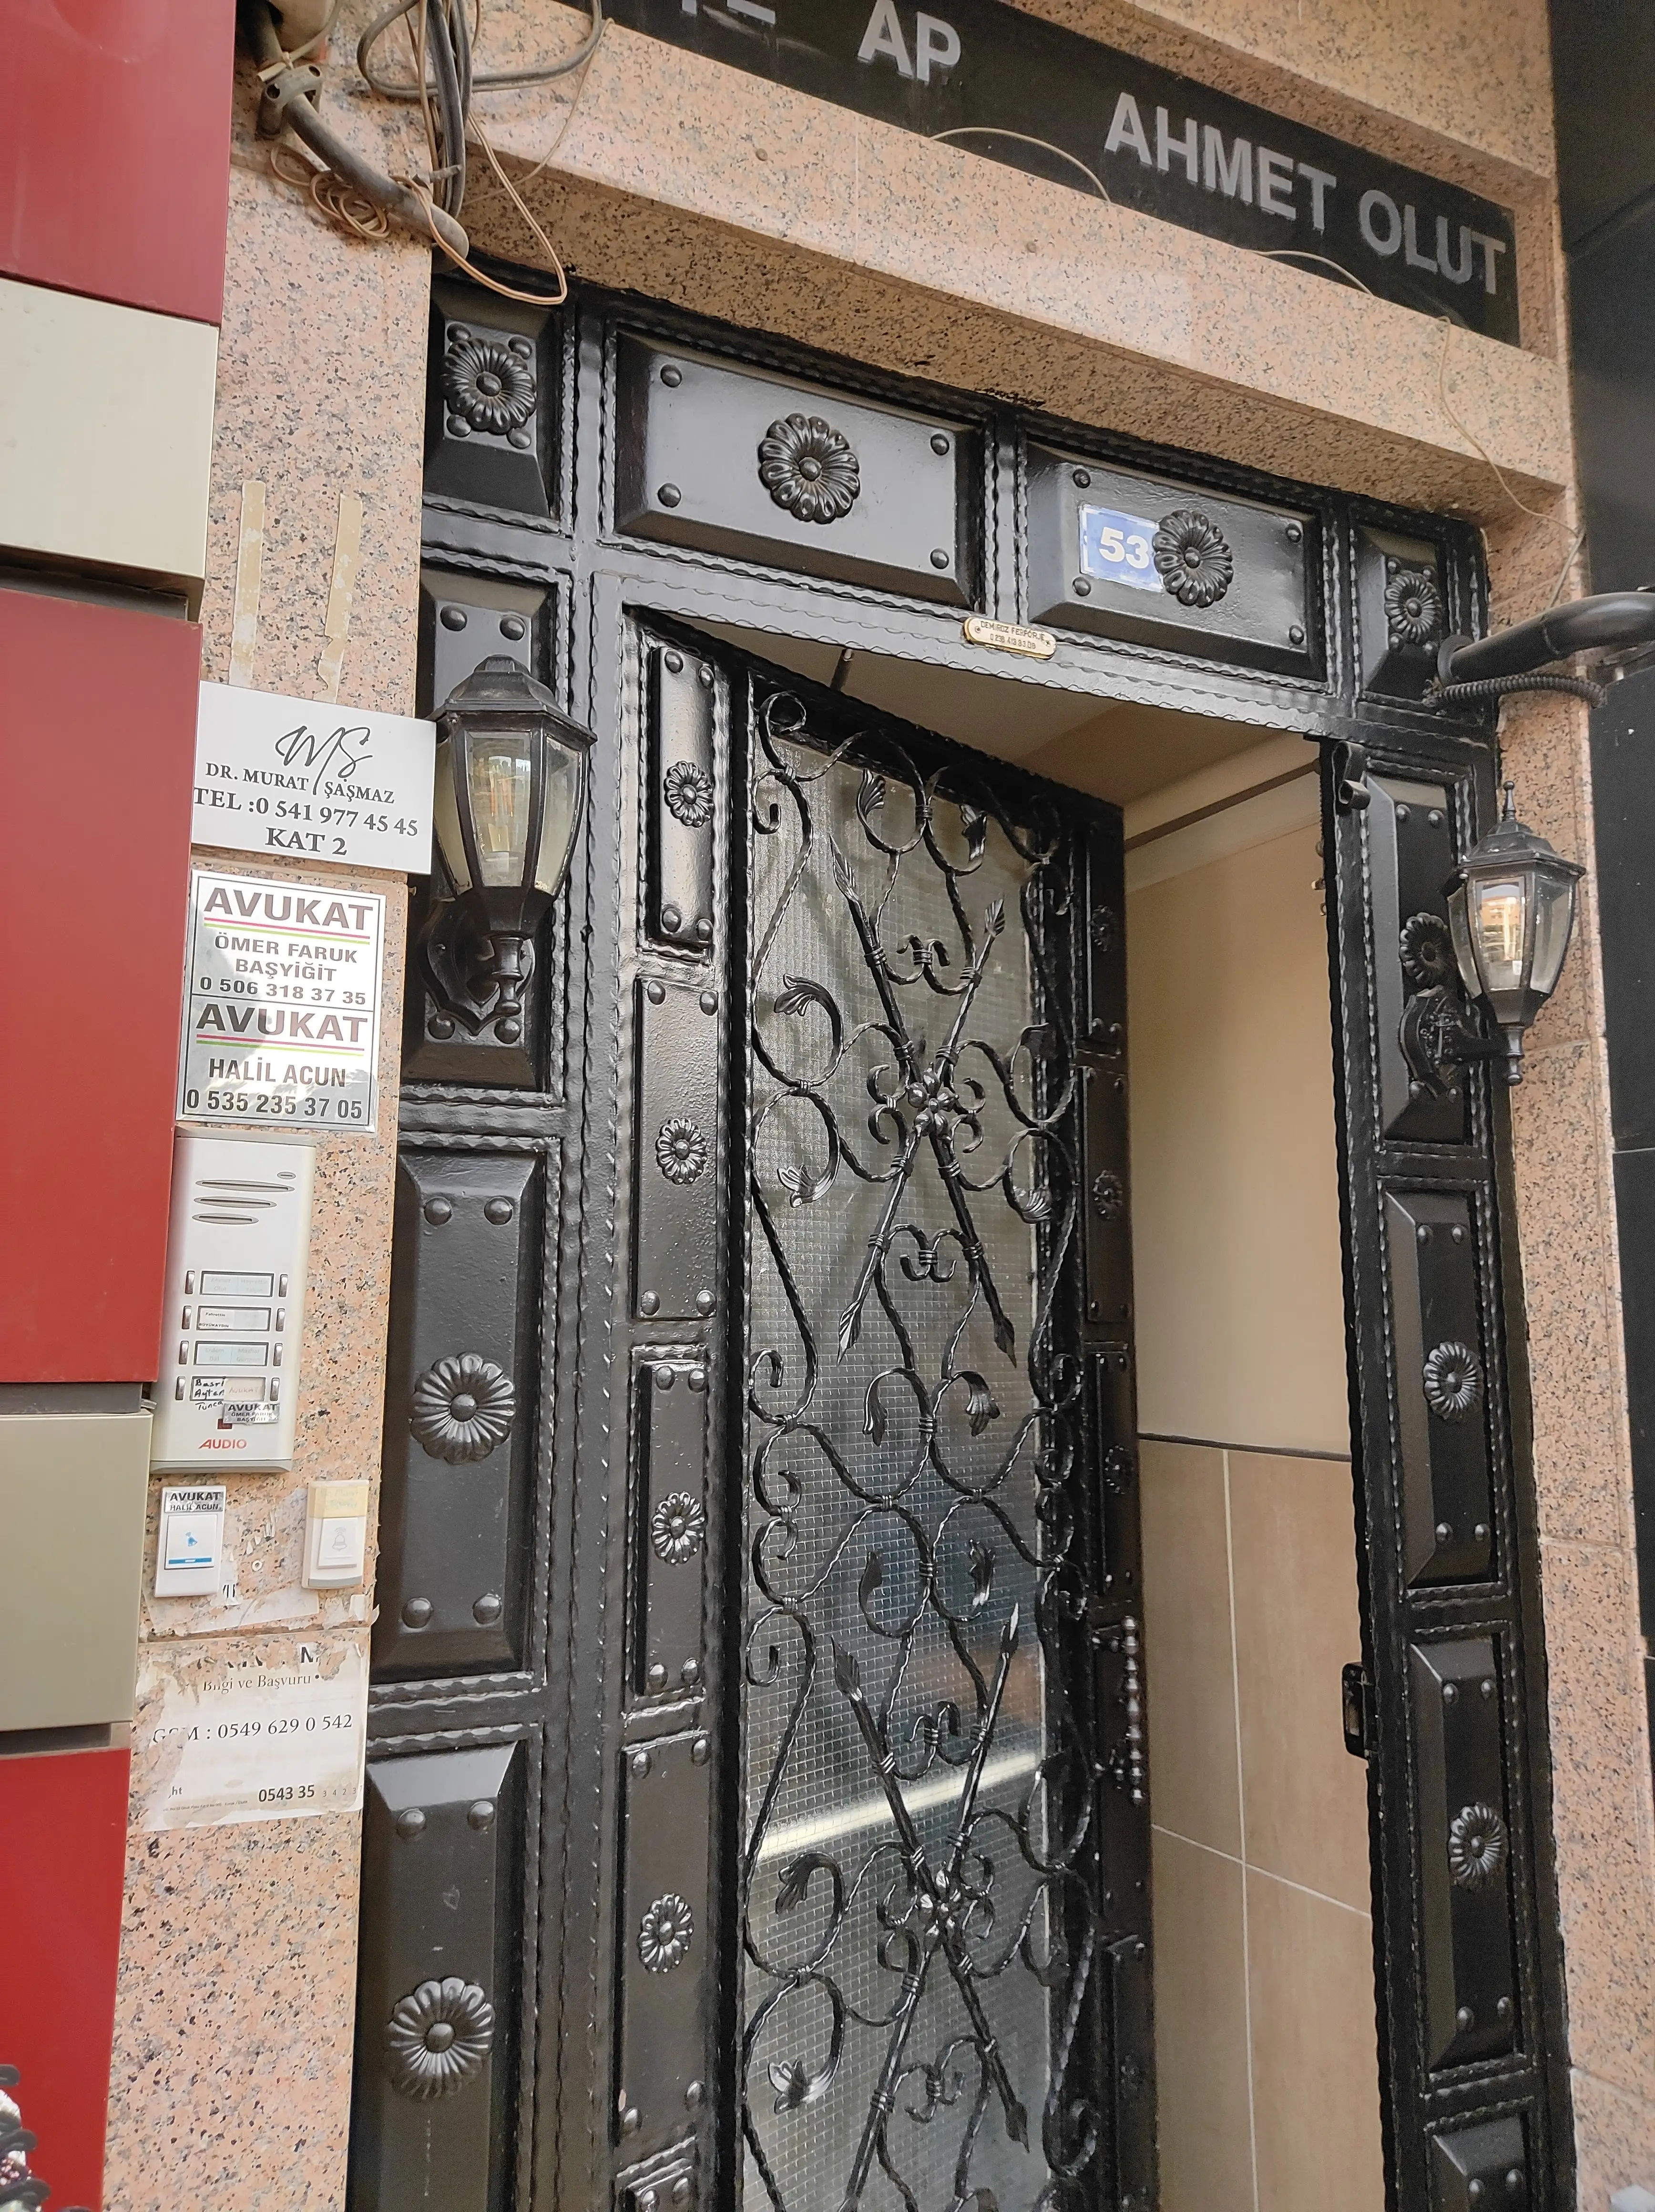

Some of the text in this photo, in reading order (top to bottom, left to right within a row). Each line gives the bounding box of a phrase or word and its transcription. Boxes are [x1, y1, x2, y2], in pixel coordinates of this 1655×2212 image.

[858, 0, 961, 82] AP
[1104, 92, 1505, 295] AHMET OLUT
[1099, 526, 1149, 568] 53
[205, 762, 395, 804] DR. MURAT ŞAŞMAZ
[275, 800, 313, 821] 541
[319, 807, 358, 828] 977
[363, 813, 388, 832] 45
[393, 818, 418, 836] 45
[265, 827, 348, 856] KAT 2
[204, 887, 373, 931] AVUKAT
[215, 932, 358, 963] ÖMER FARUK
[235, 958, 337, 982] BAŞYİĞİT
[200, 976, 366, 1005] 0 506 318 37 35
[195, 1003, 368, 1043] AVUKAT
[209, 1056, 346, 1088] HALİL ACUN
[186, 1089, 362, 1119] 0 535 235 37 05
[194, 1389, 225, 1400] Ayten
[195, 1378, 225, 1387] Basri
[195, 1401, 223, 1411] Tunca
[228, 1403, 278, 1412] AVUKAT
[198, 1438, 247, 1449] AUDIO
[170, 1492, 221, 1501] AVUKAT
[238, 1679, 253, 1689] ve
[257, 1675, 311, 1690] Başvuru
[217, 1722, 261, 1739] 0549
[268, 1718, 299, 1735] 629
[306, 1717, 316, 1731] 0
[322, 1714, 352, 1731] 542
[258, 1786, 294, 1802] 0543
[298, 1784, 315, 1799] 35
